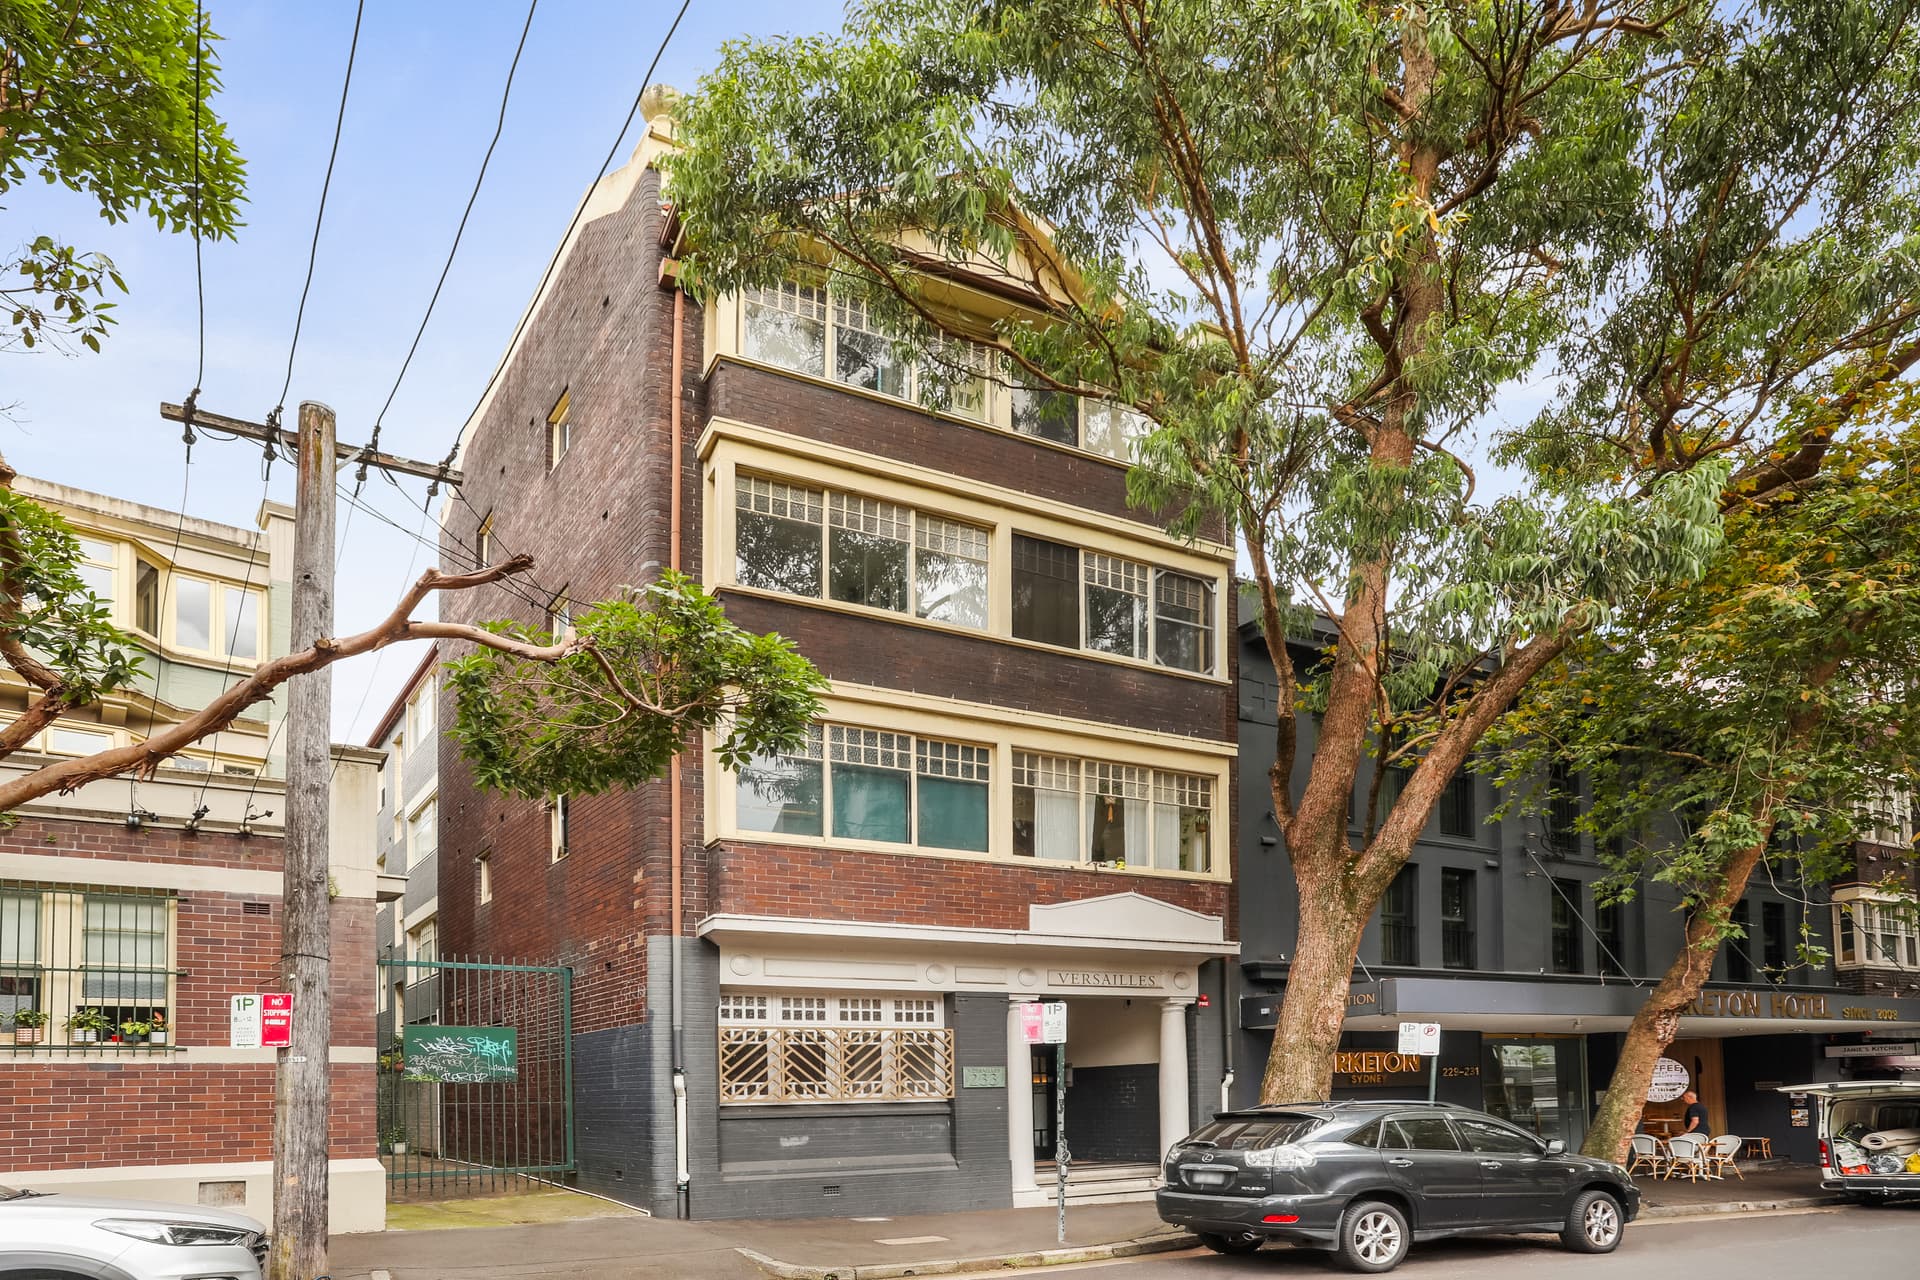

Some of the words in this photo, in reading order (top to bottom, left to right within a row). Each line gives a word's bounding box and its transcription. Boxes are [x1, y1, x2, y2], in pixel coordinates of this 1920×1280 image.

[1058, 972, 1156, 987] VERSAILLES
[271, 998, 284, 1006] NO
[1688, 991, 1761, 1017] KETON
[1771, 993, 1833, 1019] HOTEL
[1334, 1051, 1420, 1073] RKETON
[1351, 1074, 1387, 1084] SYDNEY
